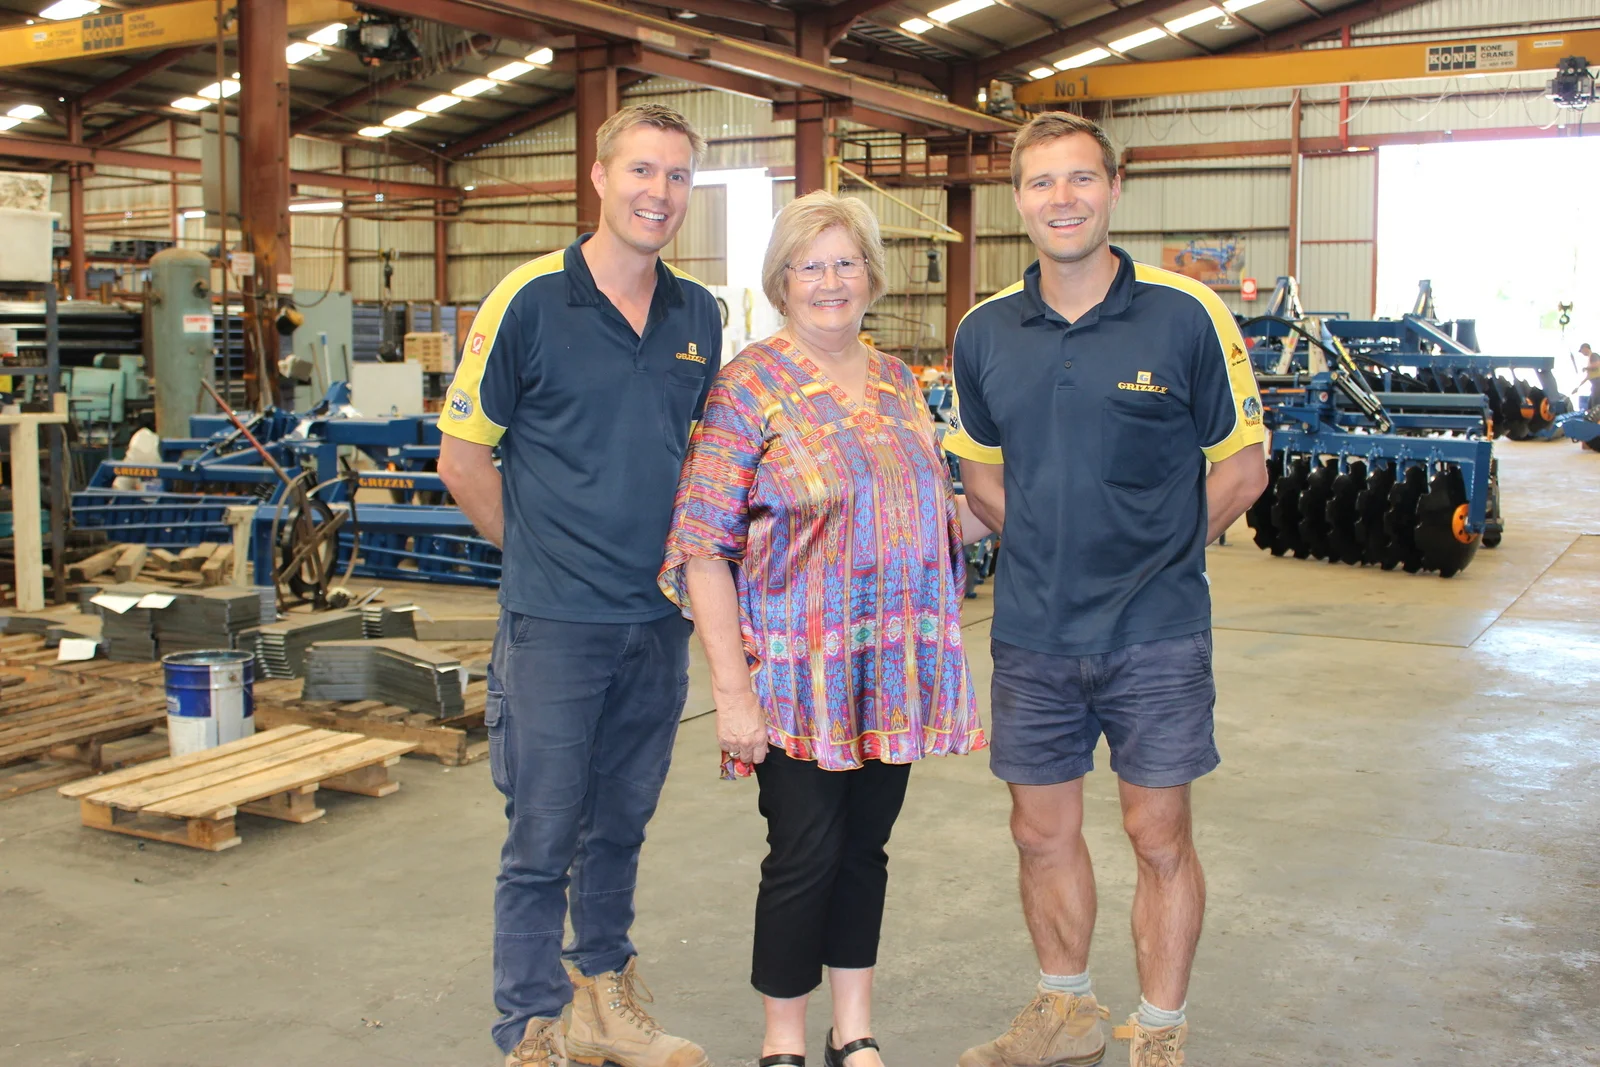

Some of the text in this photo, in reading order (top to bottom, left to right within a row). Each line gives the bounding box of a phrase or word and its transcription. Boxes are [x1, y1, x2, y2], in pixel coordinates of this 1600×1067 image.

[1481, 44, 1502, 52] KONE
[1481, 50, 1514, 58] CRANES
[1429, 51, 1476, 64] KONE
[1055, 74, 1088, 97] No 1
[1117, 382, 1168, 394] GRIZZLY
[113, 467, 158, 477] GRIZZLY
[359, 477, 414, 489] GRIZZLY
